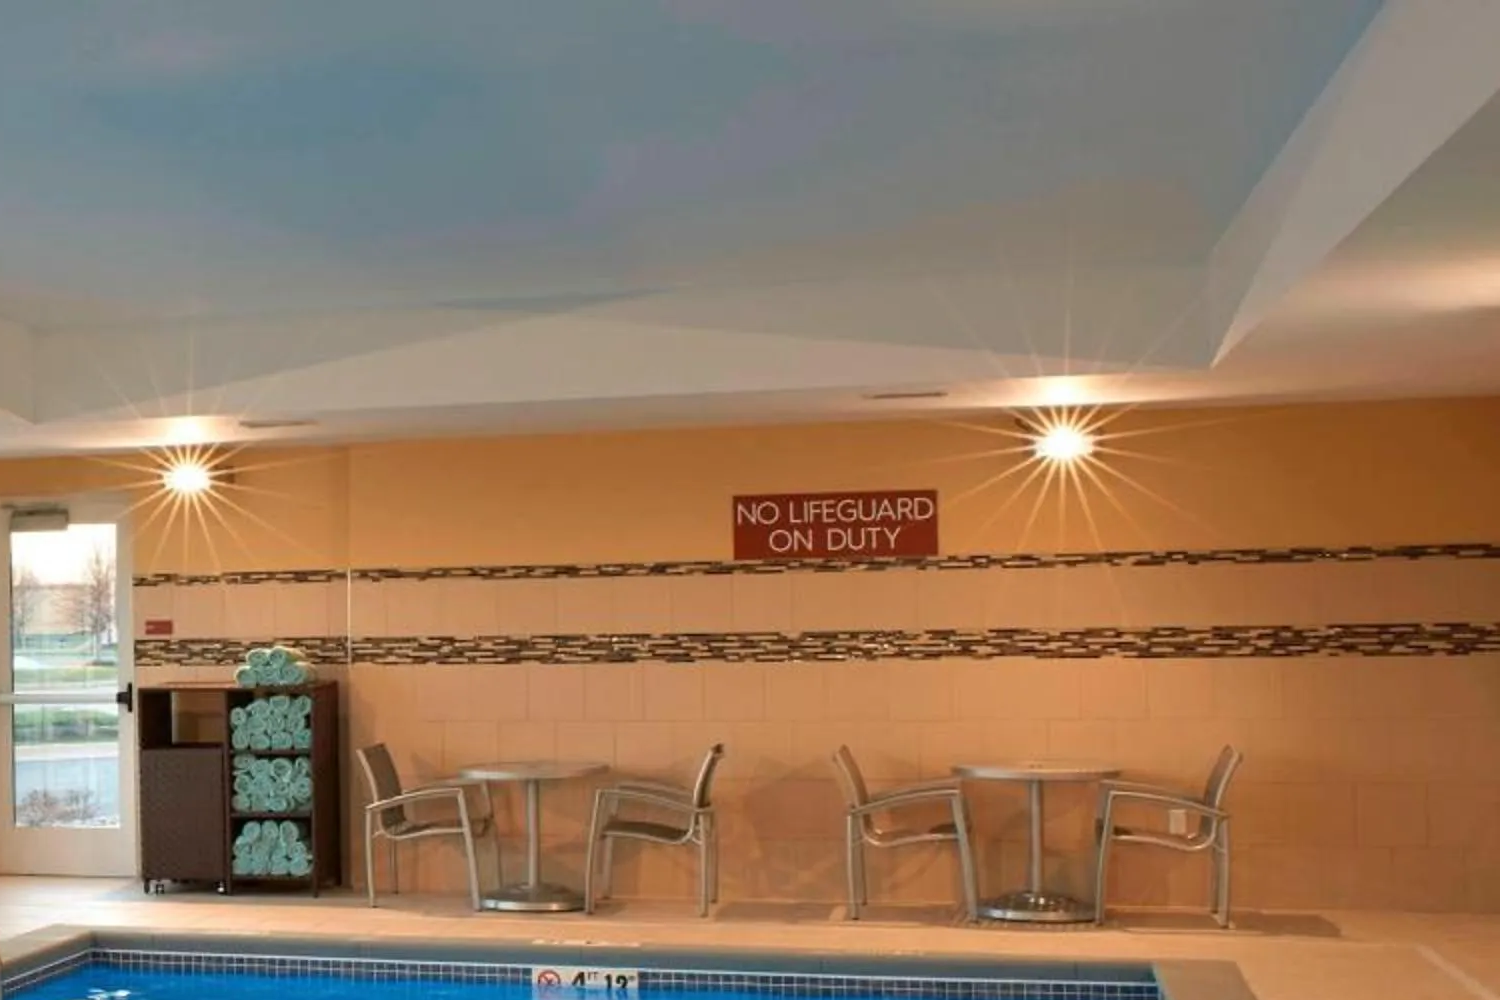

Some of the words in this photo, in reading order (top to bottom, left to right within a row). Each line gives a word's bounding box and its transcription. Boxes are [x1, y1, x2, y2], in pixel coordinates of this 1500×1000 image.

[737, 502, 780, 525] NO
[789, 497, 934, 524] LIFEGUARD
[769, 529, 812, 552] ON
[827, 526, 901, 551] DUTY
